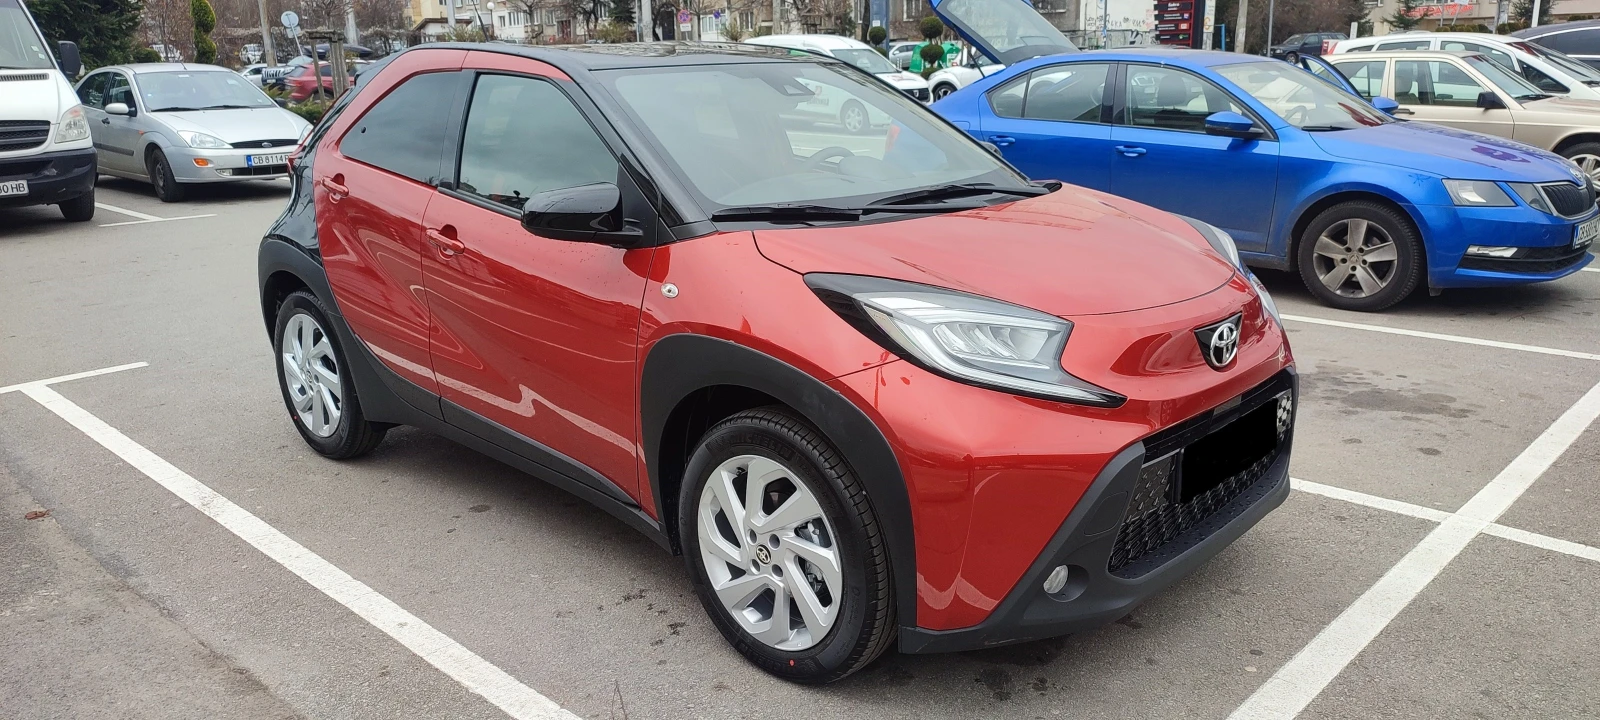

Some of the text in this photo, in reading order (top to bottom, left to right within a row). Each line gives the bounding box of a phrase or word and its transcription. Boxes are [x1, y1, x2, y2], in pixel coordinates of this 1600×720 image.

[253, 156, 264, 164] CB
[265, 155, 284, 164] 8114
[10, 182, 26, 192] HB
[731, 432, 794, 460] MICHELIN
